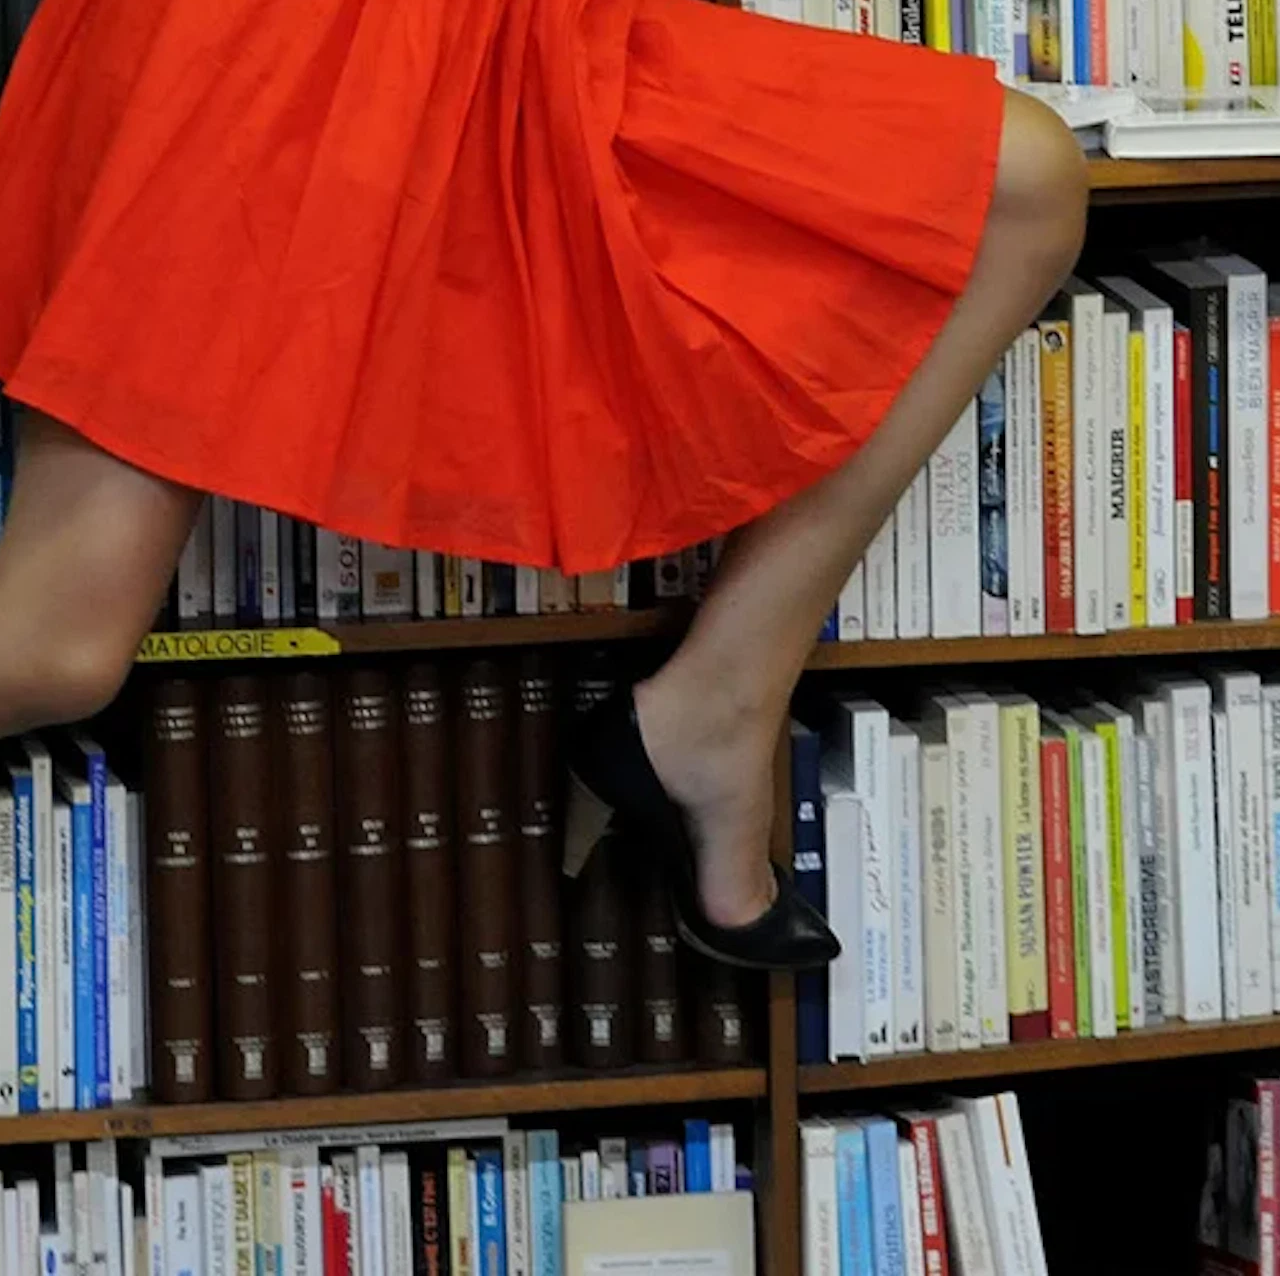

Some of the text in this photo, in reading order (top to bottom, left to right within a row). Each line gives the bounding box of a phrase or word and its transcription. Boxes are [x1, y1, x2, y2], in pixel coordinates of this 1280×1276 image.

[1247, 291, 1262, 409] BIEN MAIGRIR
[1056, 437, 1072, 514] MANGEANT
[1109, 429, 1125, 520] MAIGRIR
[1056, 540, 1072, 598] MAIGRIR
[0, 809, 13, 892] L'ASTHME
[1017, 833, 1036, 958] SUSAN POWTER
